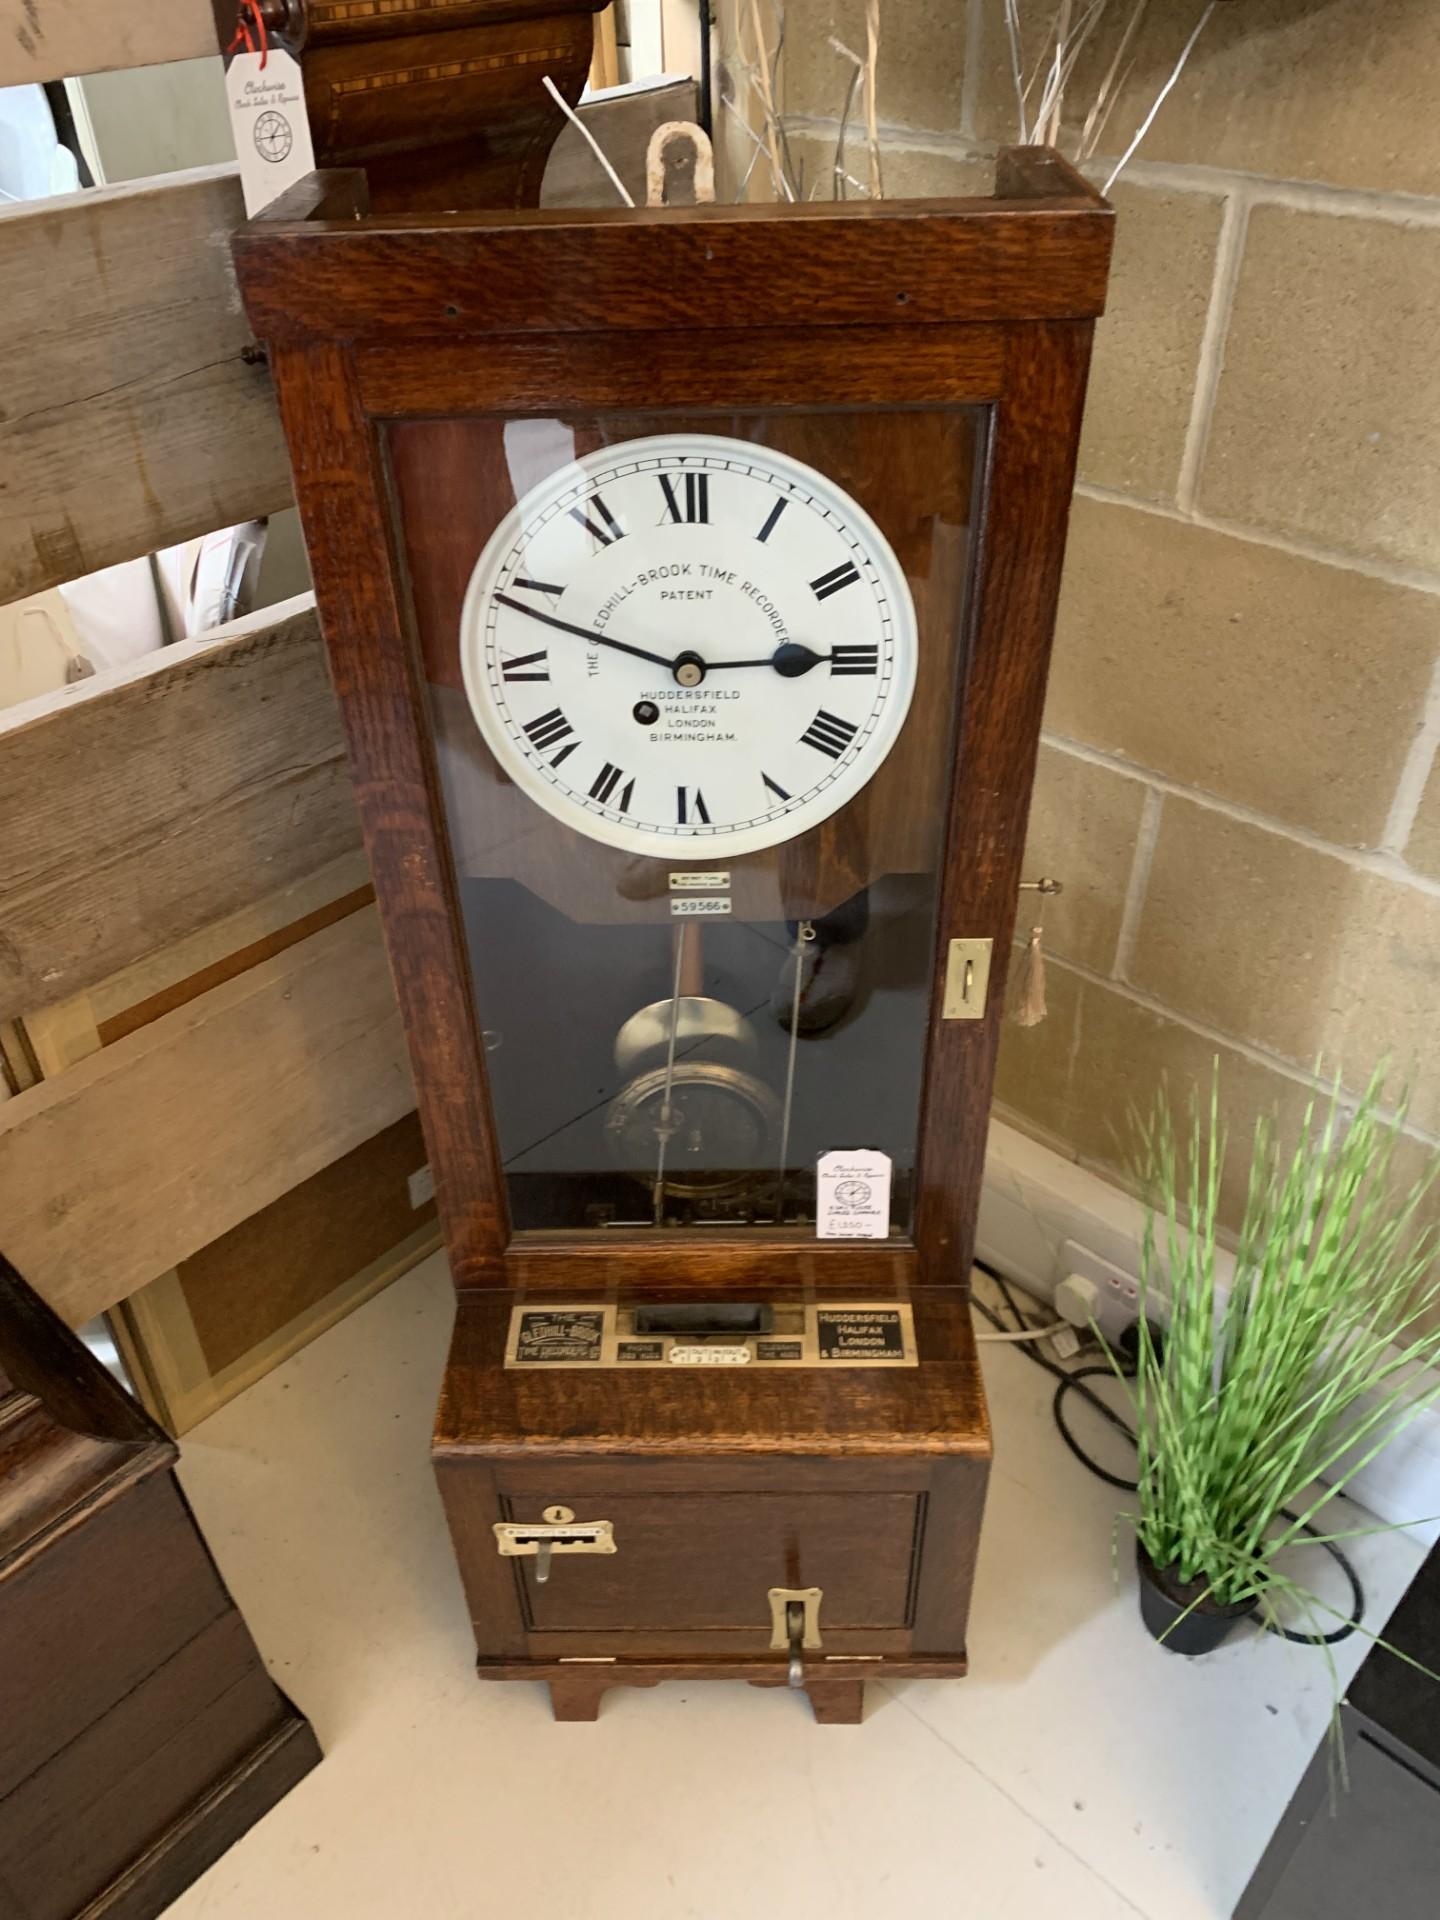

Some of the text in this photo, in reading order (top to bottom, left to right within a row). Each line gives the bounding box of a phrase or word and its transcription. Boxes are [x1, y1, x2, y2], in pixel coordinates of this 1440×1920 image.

[655, 471, 715, 527] XII
[567, 491, 631, 556] XI
[660, 590, 714, 600] PATENT
[586, 651, 600, 678] THE
[699, 564, 738, 586] TIME
[829, 643, 879, 676] III
[640, 690, 741, 700] HUDDERSFIELD
[664, 705, 717, 714] HALIFAX
[668, 719, 716, 728] LONDON
[681, 902, 721, 911] 59566
[820, 1312, 898, 1323] HUDDERSFIELD
[837, 1324, 884, 1334] HALIFAX
[838, 1336, 885, 1346] LONDON
[831, 1347, 903, 1358] BIRMINGHAM
